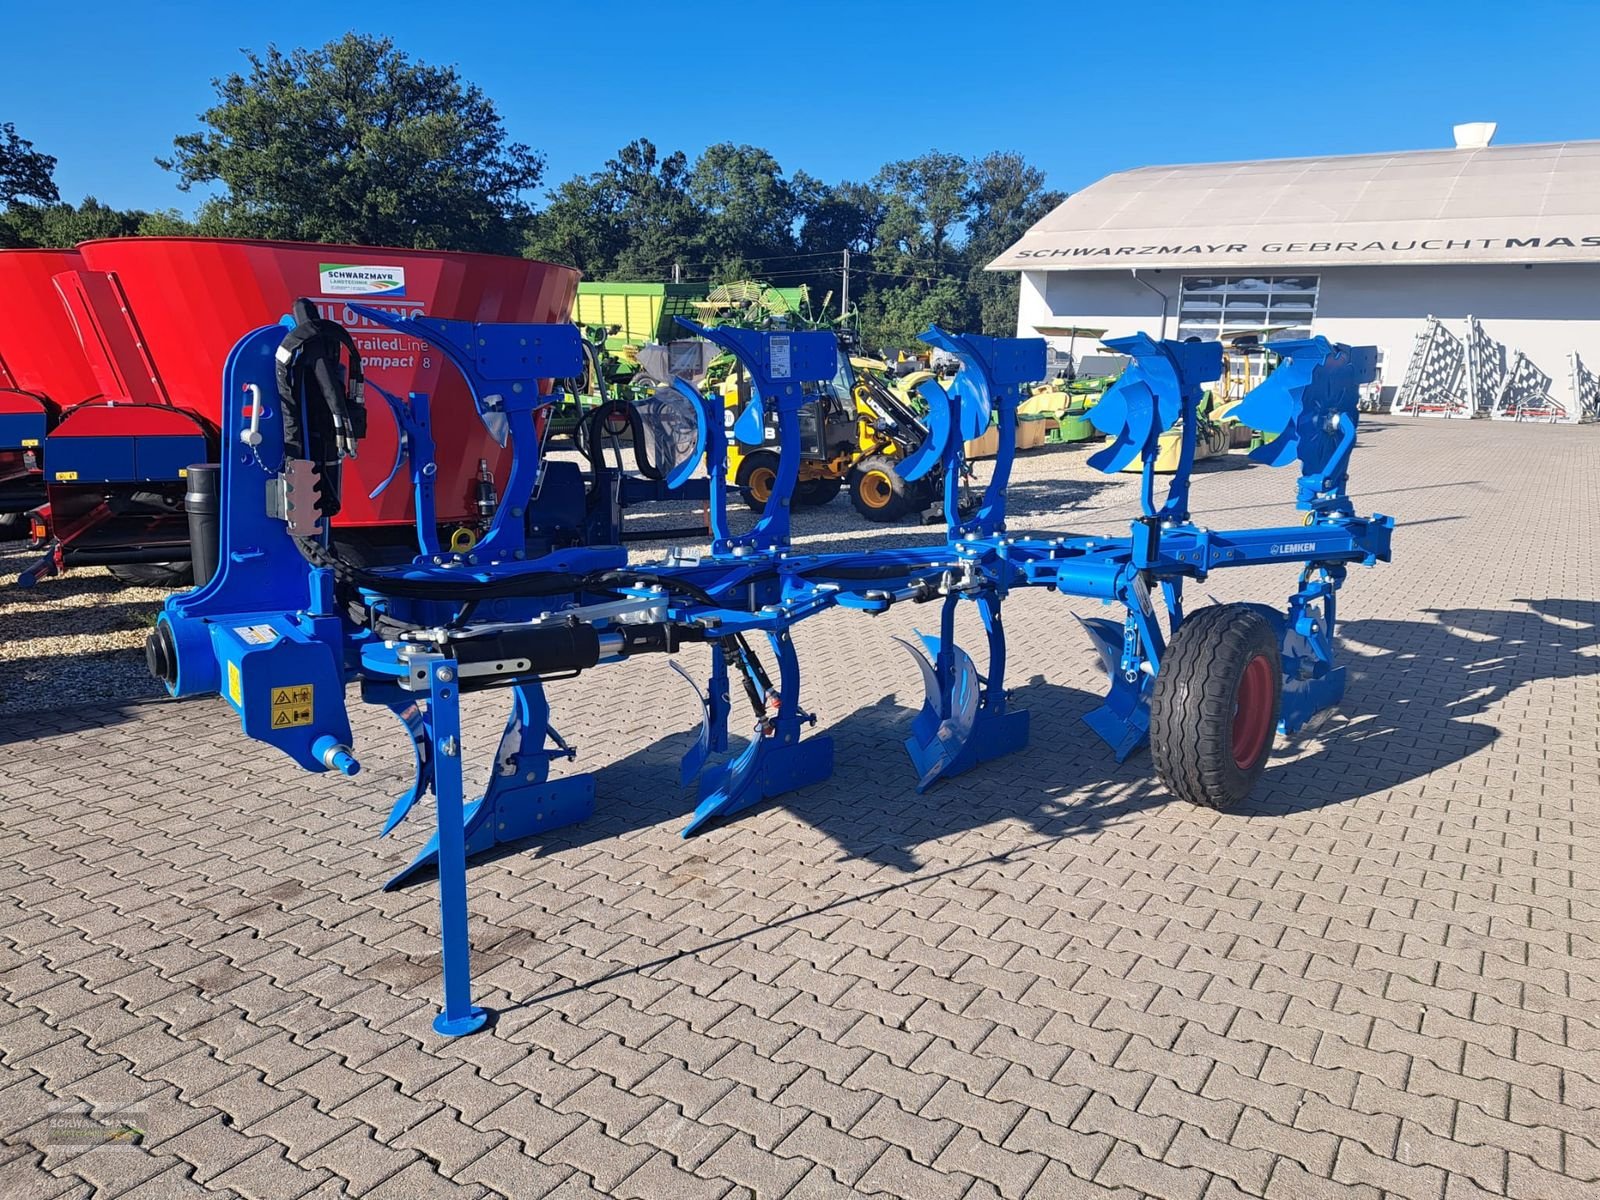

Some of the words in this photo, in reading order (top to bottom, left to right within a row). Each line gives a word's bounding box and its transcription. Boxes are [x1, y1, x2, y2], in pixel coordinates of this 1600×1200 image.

[1015, 243, 1248, 259] SCHWARZMAYR
[328, 271, 393, 280] SCHWARZMAYR
[361, 355, 415, 371] ompact
[422, 356, 431, 370] 8
[1280, 542, 1316, 554] LEMKEN
